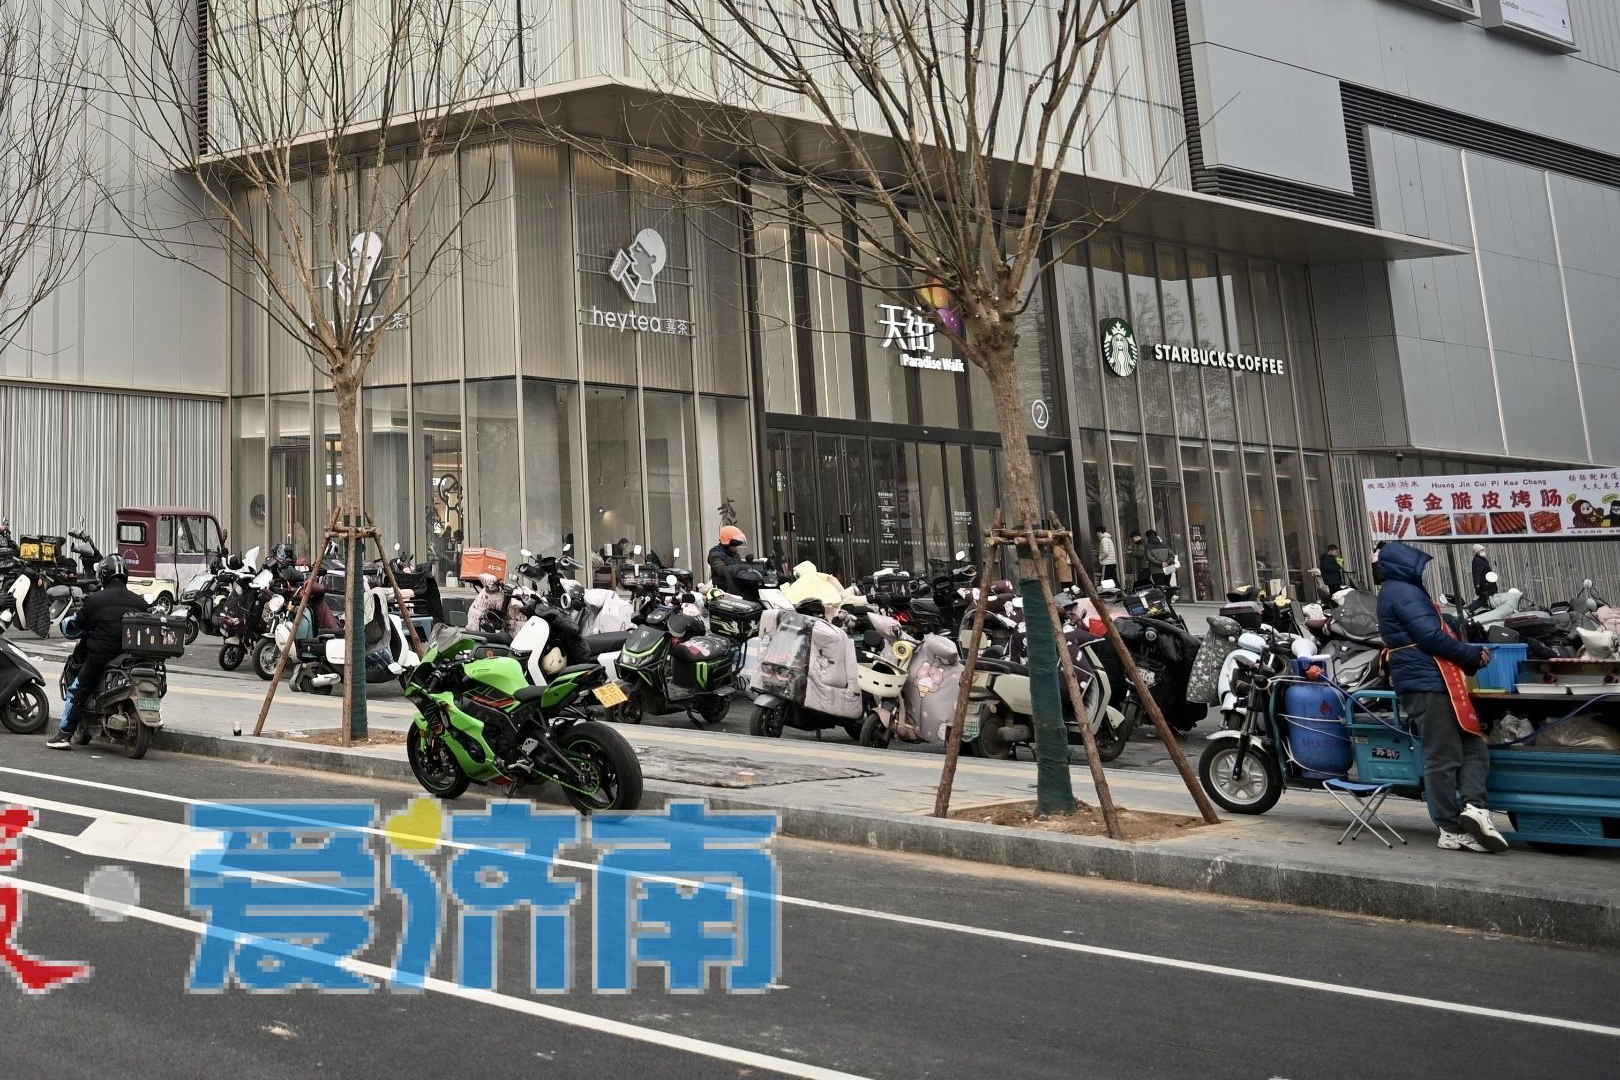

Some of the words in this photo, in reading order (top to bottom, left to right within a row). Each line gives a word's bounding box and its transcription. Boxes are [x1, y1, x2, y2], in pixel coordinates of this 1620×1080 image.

[593, 305, 661, 333] heytea
[665, 318, 688, 335] 喜茶
[875, 303, 936, 352] 天街
[900, 354, 942, 370] Paradise
[941, 357, 965, 373] Walk
[1154, 343, 1235, 369] STARBUCKS
[1236, 354, 1284, 375] COFFEE
[1431, 481, 1455, 489] Huang
[1459, 480, 1471, 488] Jin
[1522, 478, 1547, 486] Chang
[1395, 488, 1562, 513] 黄金脆皮烤肠
